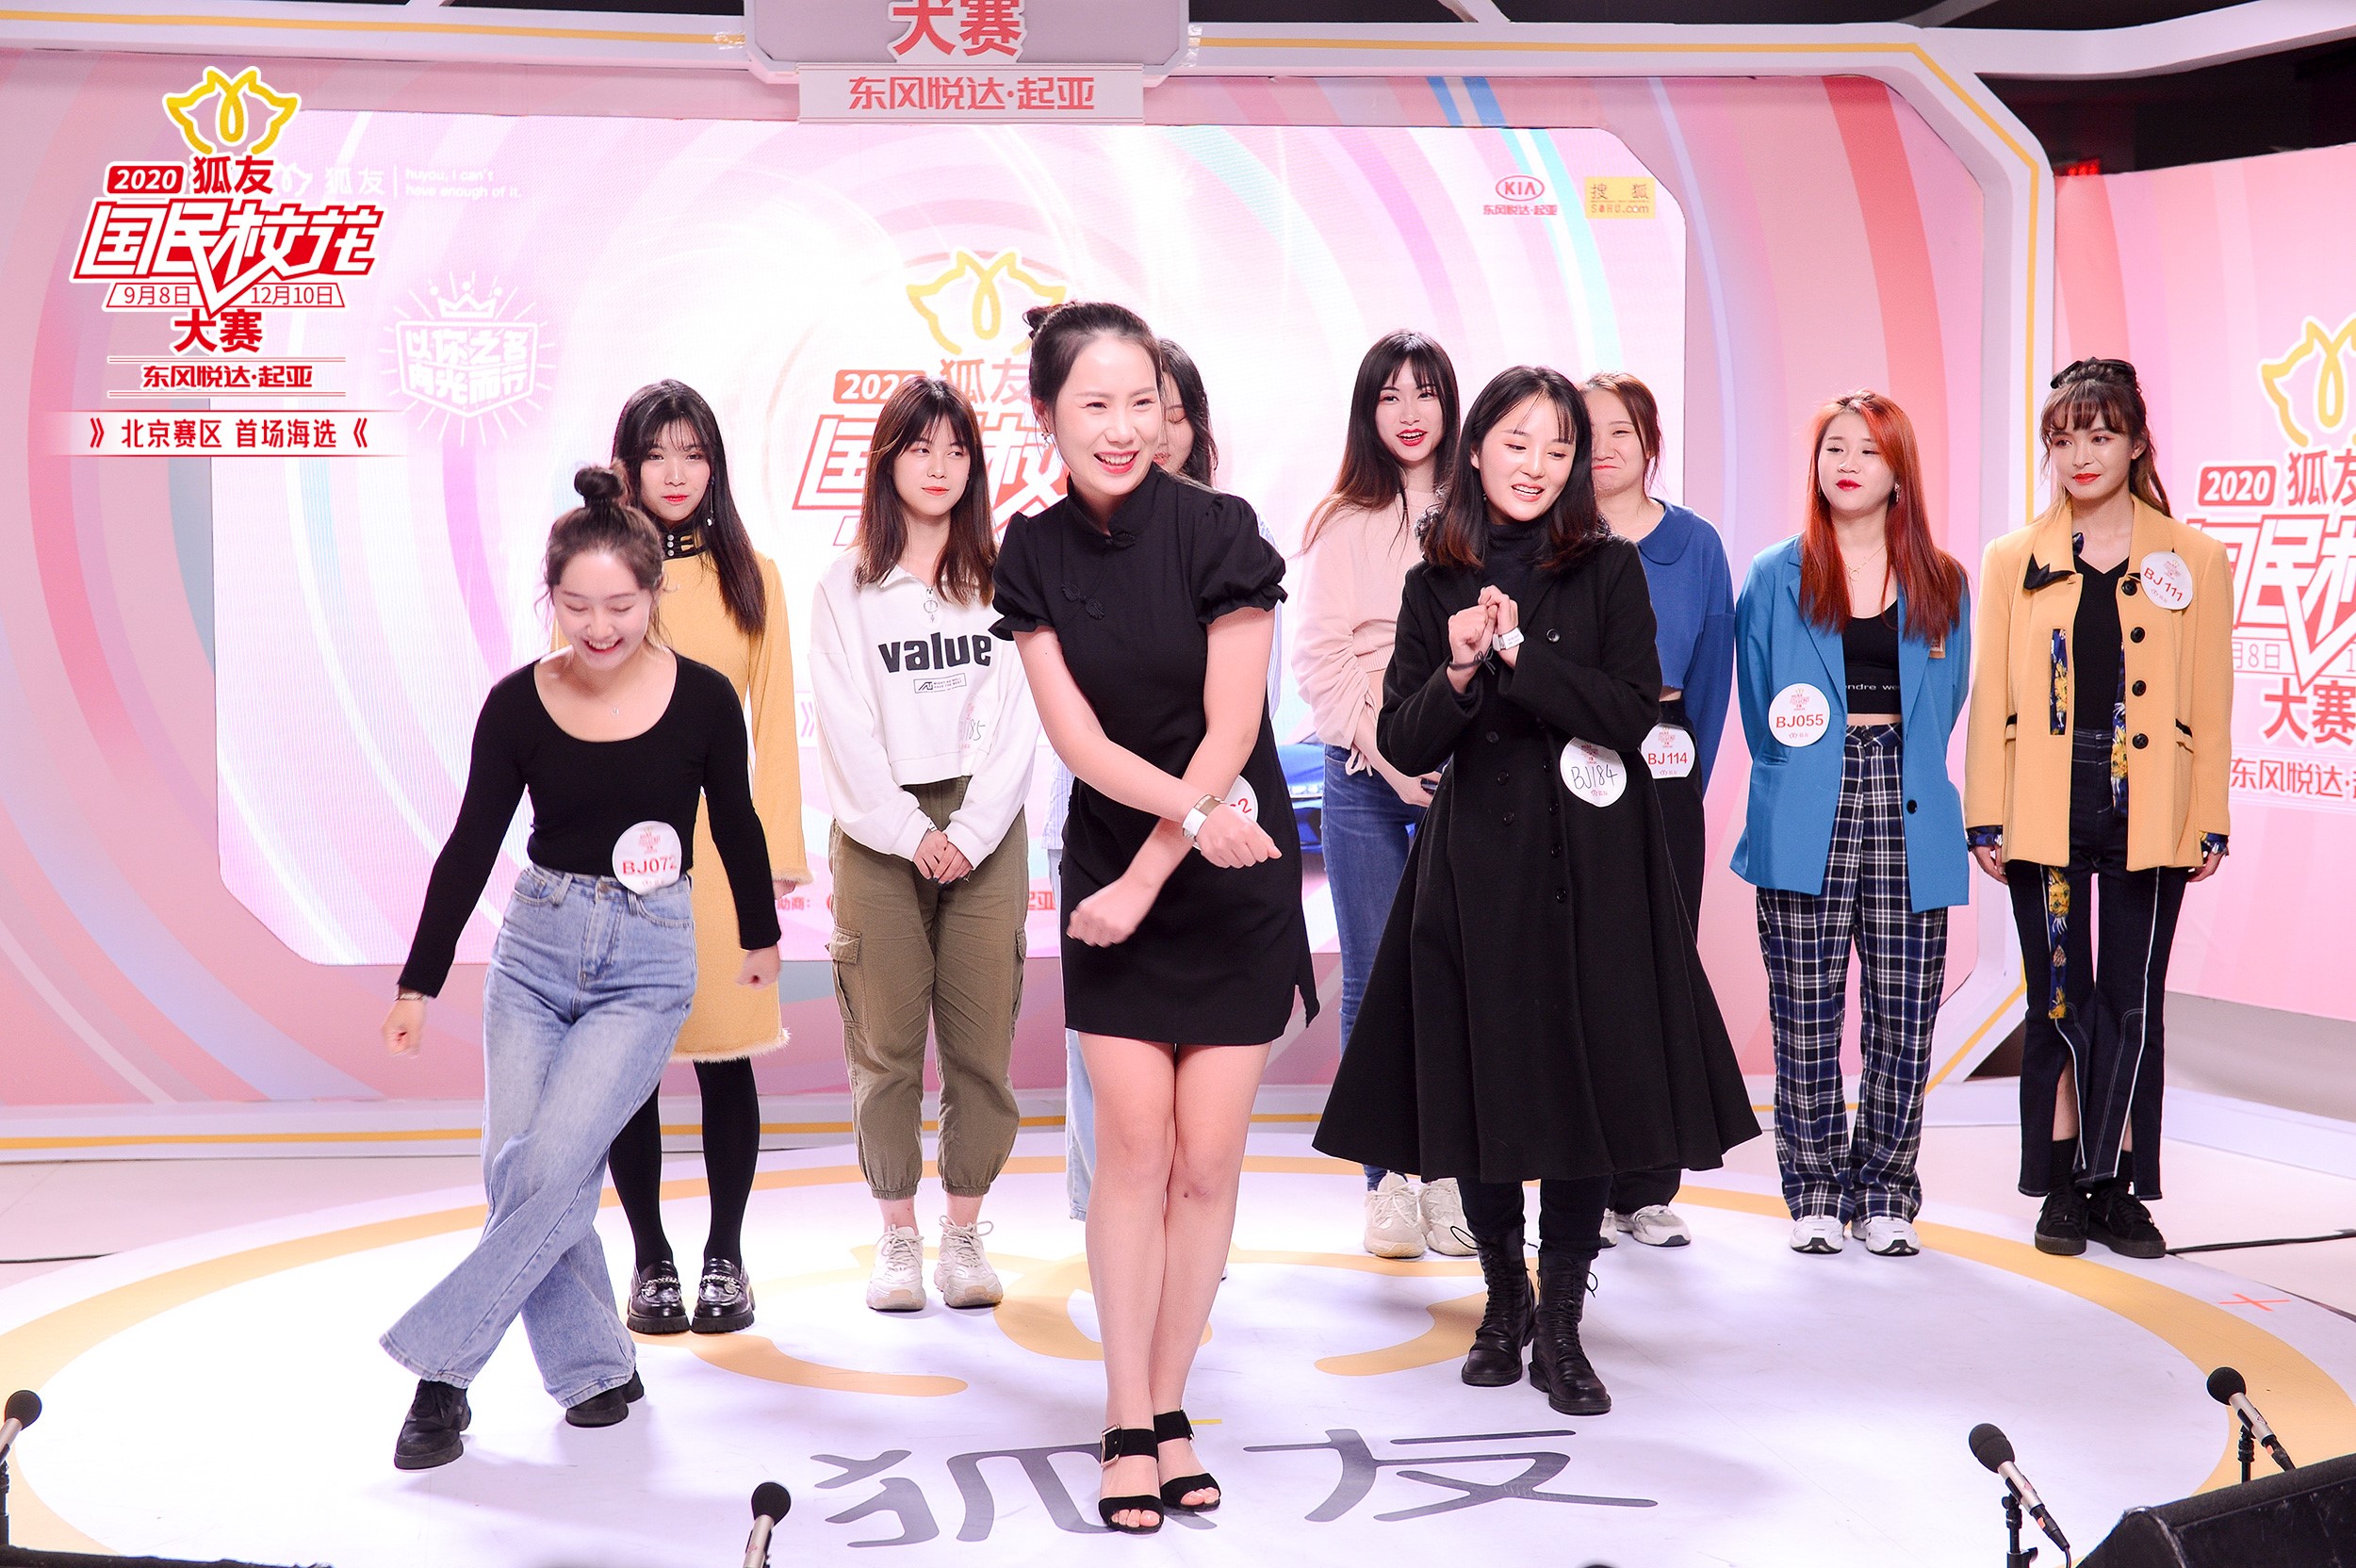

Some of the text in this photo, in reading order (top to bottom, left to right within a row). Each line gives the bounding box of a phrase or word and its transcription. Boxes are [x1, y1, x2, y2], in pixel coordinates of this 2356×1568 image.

[892, 0, 1023, 57] 大赛
[848, 75, 1095, 111] 东风悦达·起亚
[325, 167, 385, 195] 狐友
[440, 185, 488, 200] enough
[491, 186, 506, 198] of
[1504, 181, 1537, 196] KIA
[841, 373, 911, 400] 202
[2202, 469, 2271, 502] 2020
[877, 631, 992, 674] value
[1775, 713, 1824, 728] BJ055
[2264, 677, 2356, 746] 大赛
[1648, 752, 1688, 765] BJ114
[1570, 764, 1618, 790] BJ184
[2231, 758, 2356, 799] 东风悦达·
[622, 855, 678, 875] BJ072
